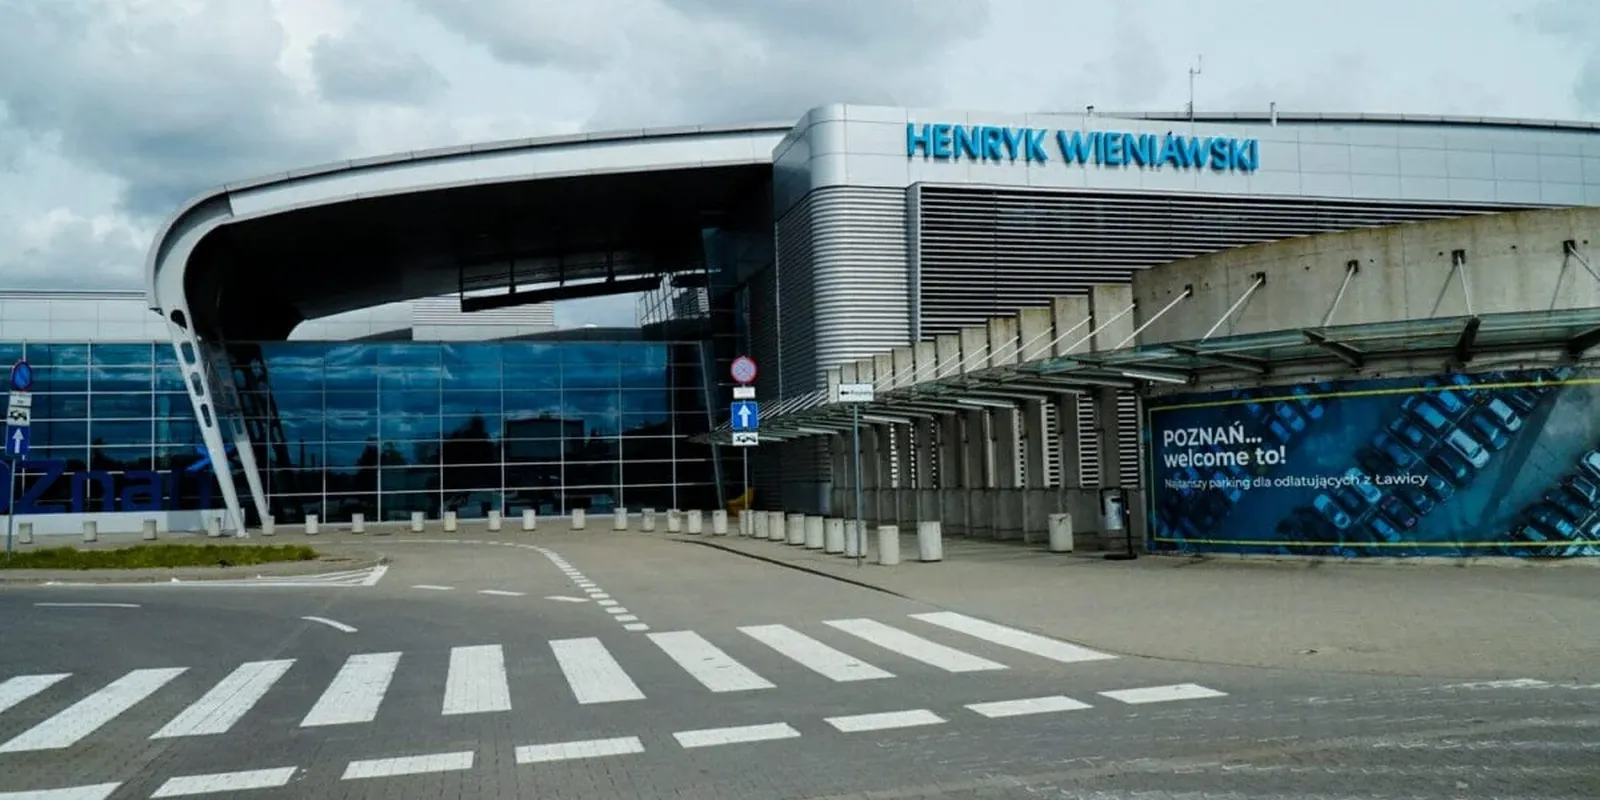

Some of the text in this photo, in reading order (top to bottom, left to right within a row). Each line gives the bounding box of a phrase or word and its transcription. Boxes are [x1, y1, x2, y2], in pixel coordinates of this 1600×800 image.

[907, 122, 1258, 173] HENRYK WIENIAWSKI
[1163, 421, 1262, 447] POZNAŃ...
[1163, 445, 1286, 467] welcome to!
[1209, 476, 1251, 490] parking
[1253, 475, 1271, 488] dla
[1364, 475, 1371, 485] z
[1375, 473, 1428, 487] Ławicy
